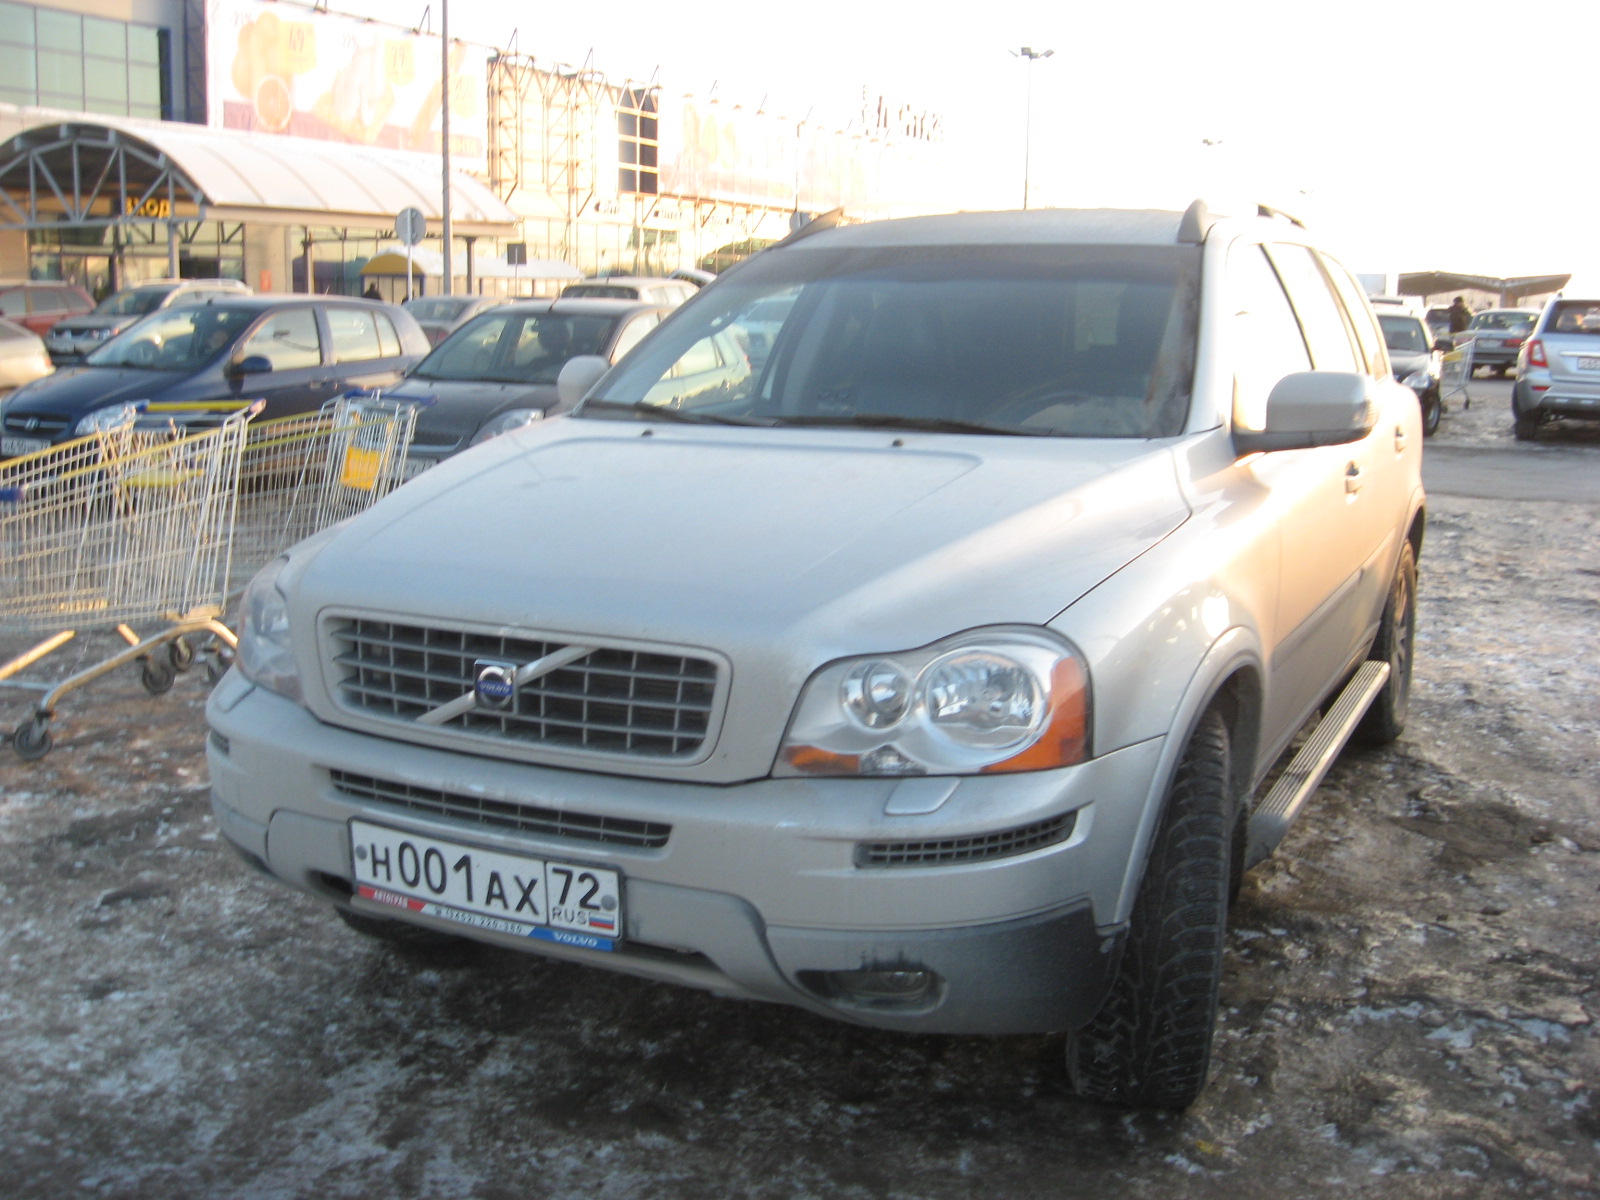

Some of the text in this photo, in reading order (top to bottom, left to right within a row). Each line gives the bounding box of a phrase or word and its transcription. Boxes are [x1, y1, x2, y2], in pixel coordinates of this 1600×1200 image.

[552, 866, 601, 911] 72
[552, 907, 588, 926] RUS
[552, 929, 598, 947] VOLVO
